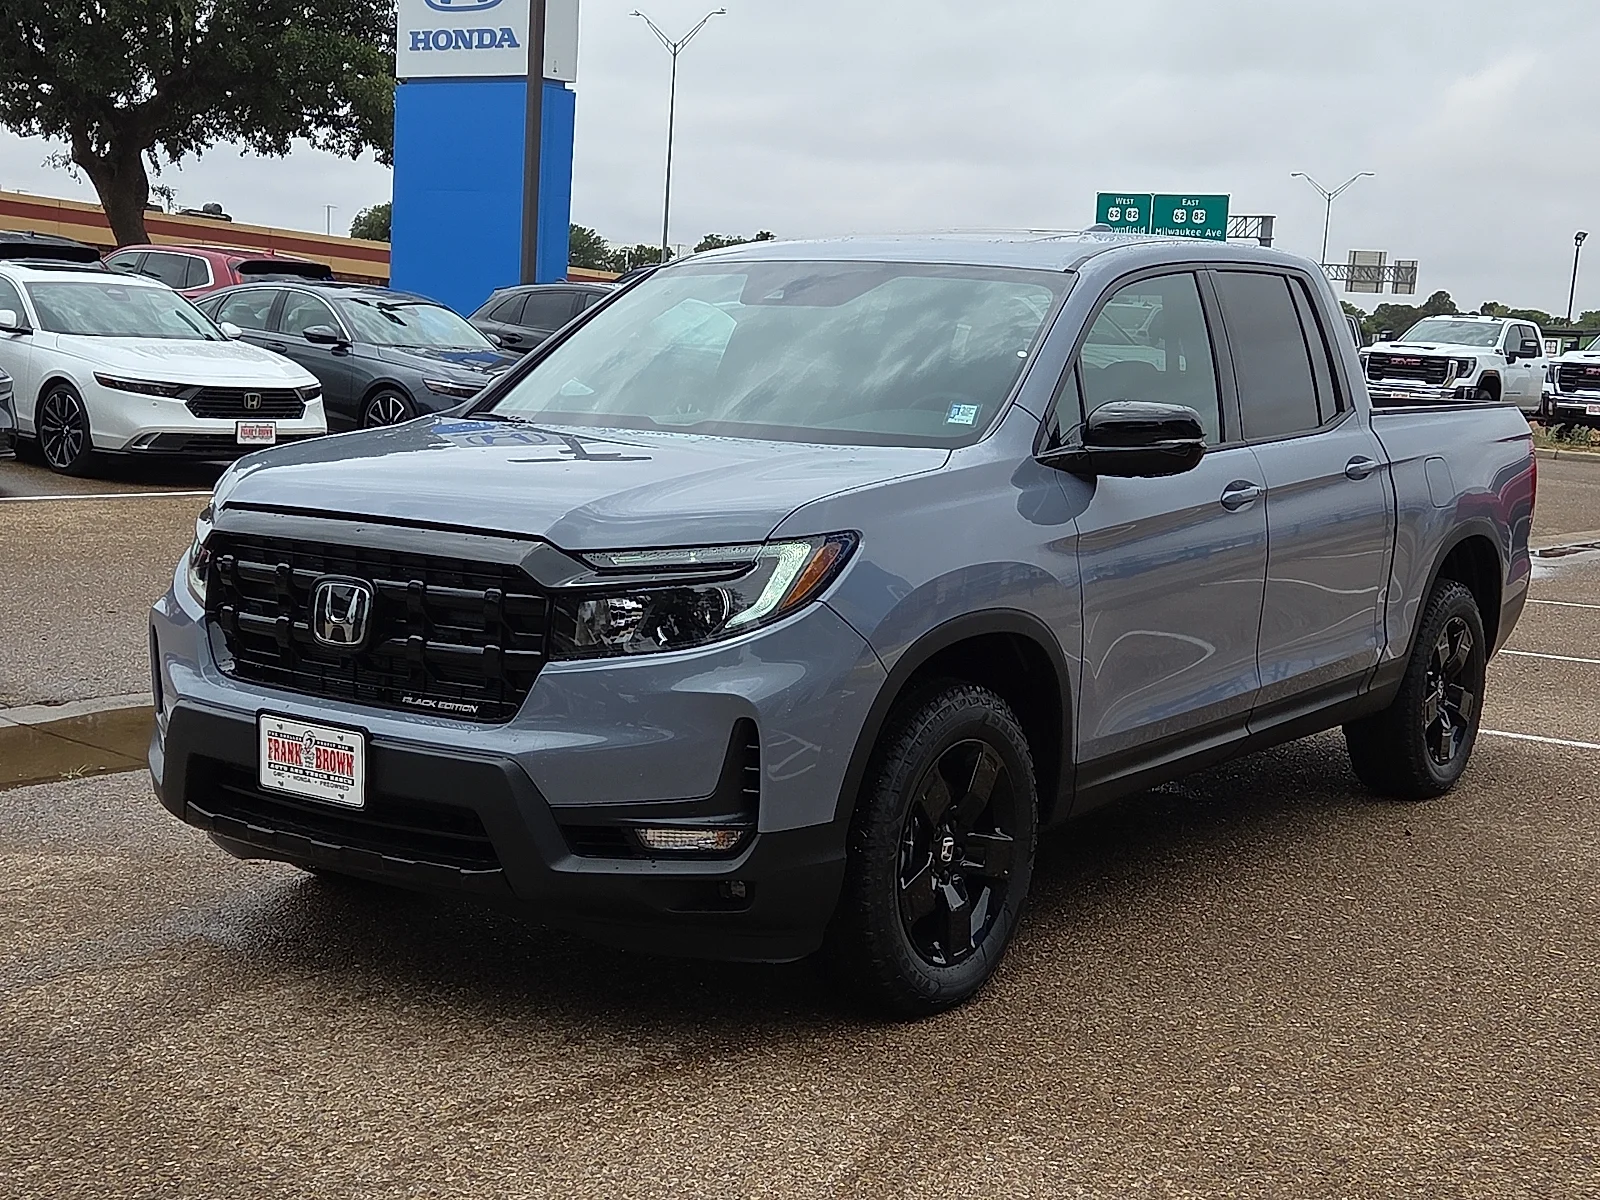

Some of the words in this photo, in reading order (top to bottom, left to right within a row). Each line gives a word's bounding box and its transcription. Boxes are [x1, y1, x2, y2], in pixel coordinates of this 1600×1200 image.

[409, 28, 520, 51] HONDA
[1115, 197, 1134, 205] WEST
[1182, 198, 1199, 206] EAST
[1109, 209, 1119, 218] 62
[1127, 210, 1138, 219] 82
[1174, 211, 1185, 220] 62
[1193, 212, 1204, 221] 82
[1155, 227, 1202, 237] Milwaukee
[1205, 228, 1222, 237] Ave
[437, 700, 478, 713] EDITION
[267, 737, 303, 767] FRANK
[314, 746, 355, 777] BROWN
